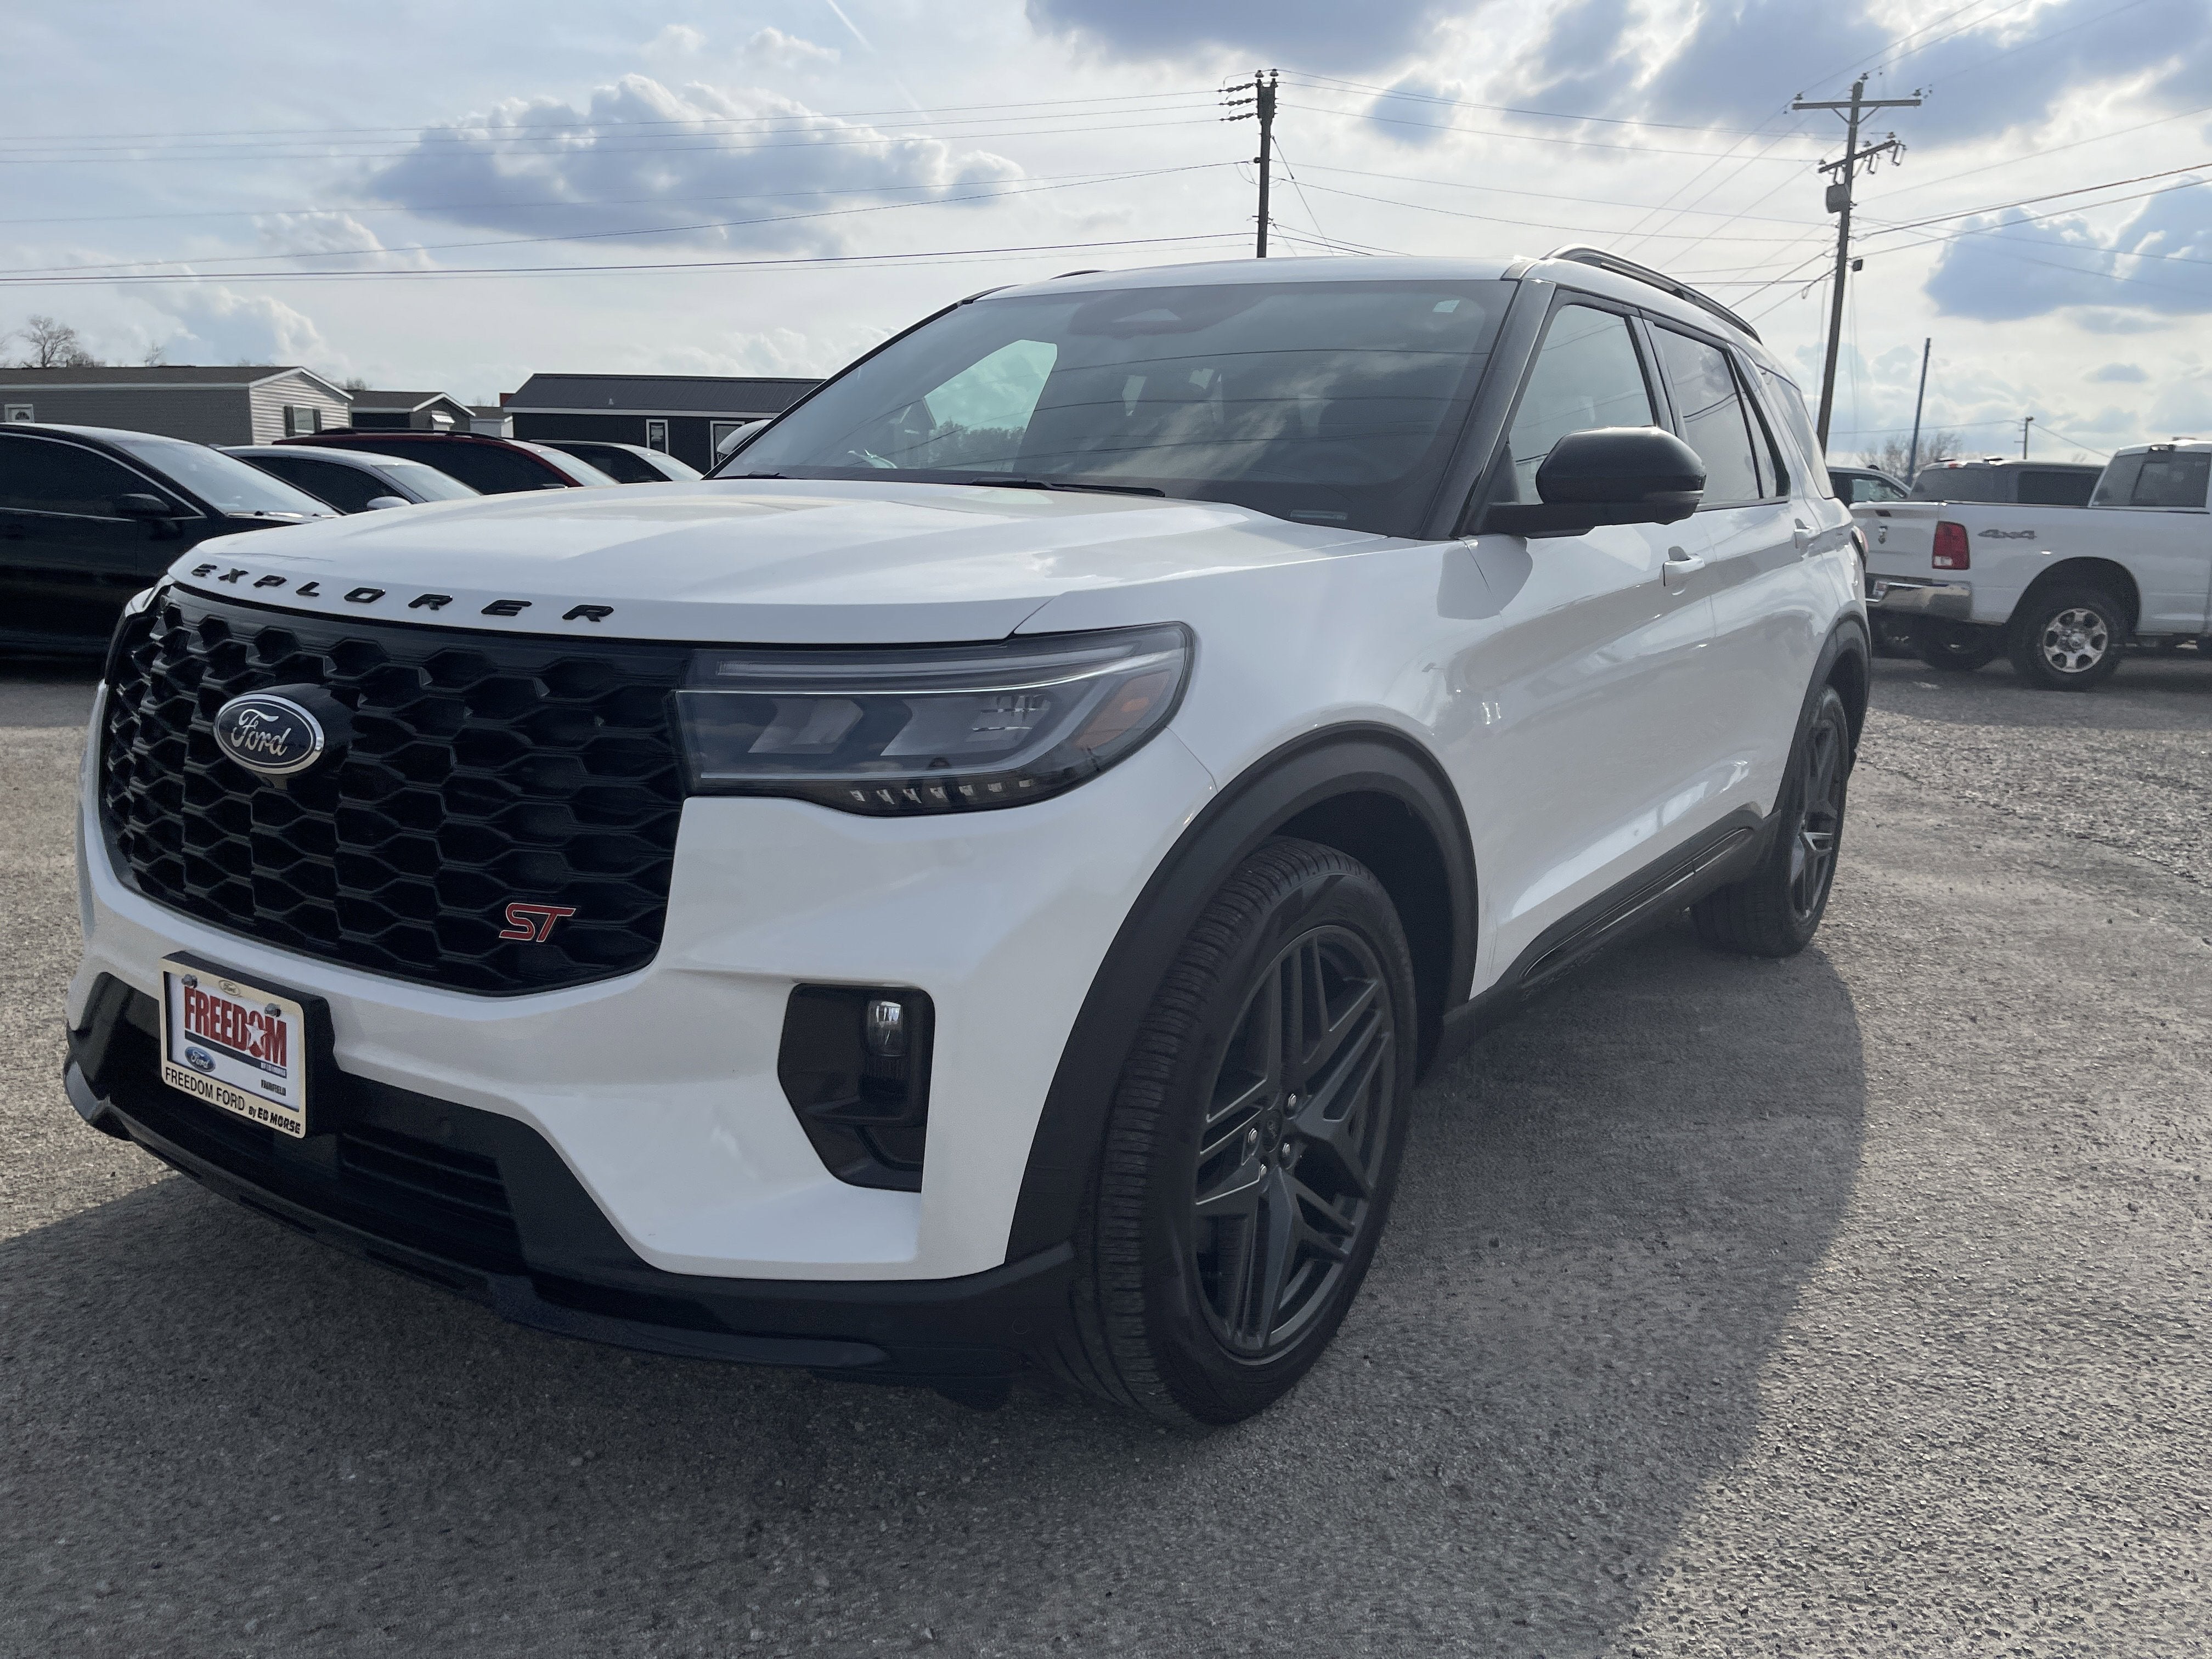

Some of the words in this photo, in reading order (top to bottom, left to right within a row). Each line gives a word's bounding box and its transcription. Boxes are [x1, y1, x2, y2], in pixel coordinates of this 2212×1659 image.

[191, 563, 614, 623] EXPLORER
[231, 709, 291, 756] Ford
[499, 902, 576, 943] ST
[184, 986, 286, 1067] FREEDOM
[191, 1050, 210, 1069] Ford
[165, 1066, 213, 1099] FREEDOM
[216, 1087, 246, 1111] FORD
[258, 1107, 269, 1121] ED
[270, 1112, 301, 1134] MORSE
